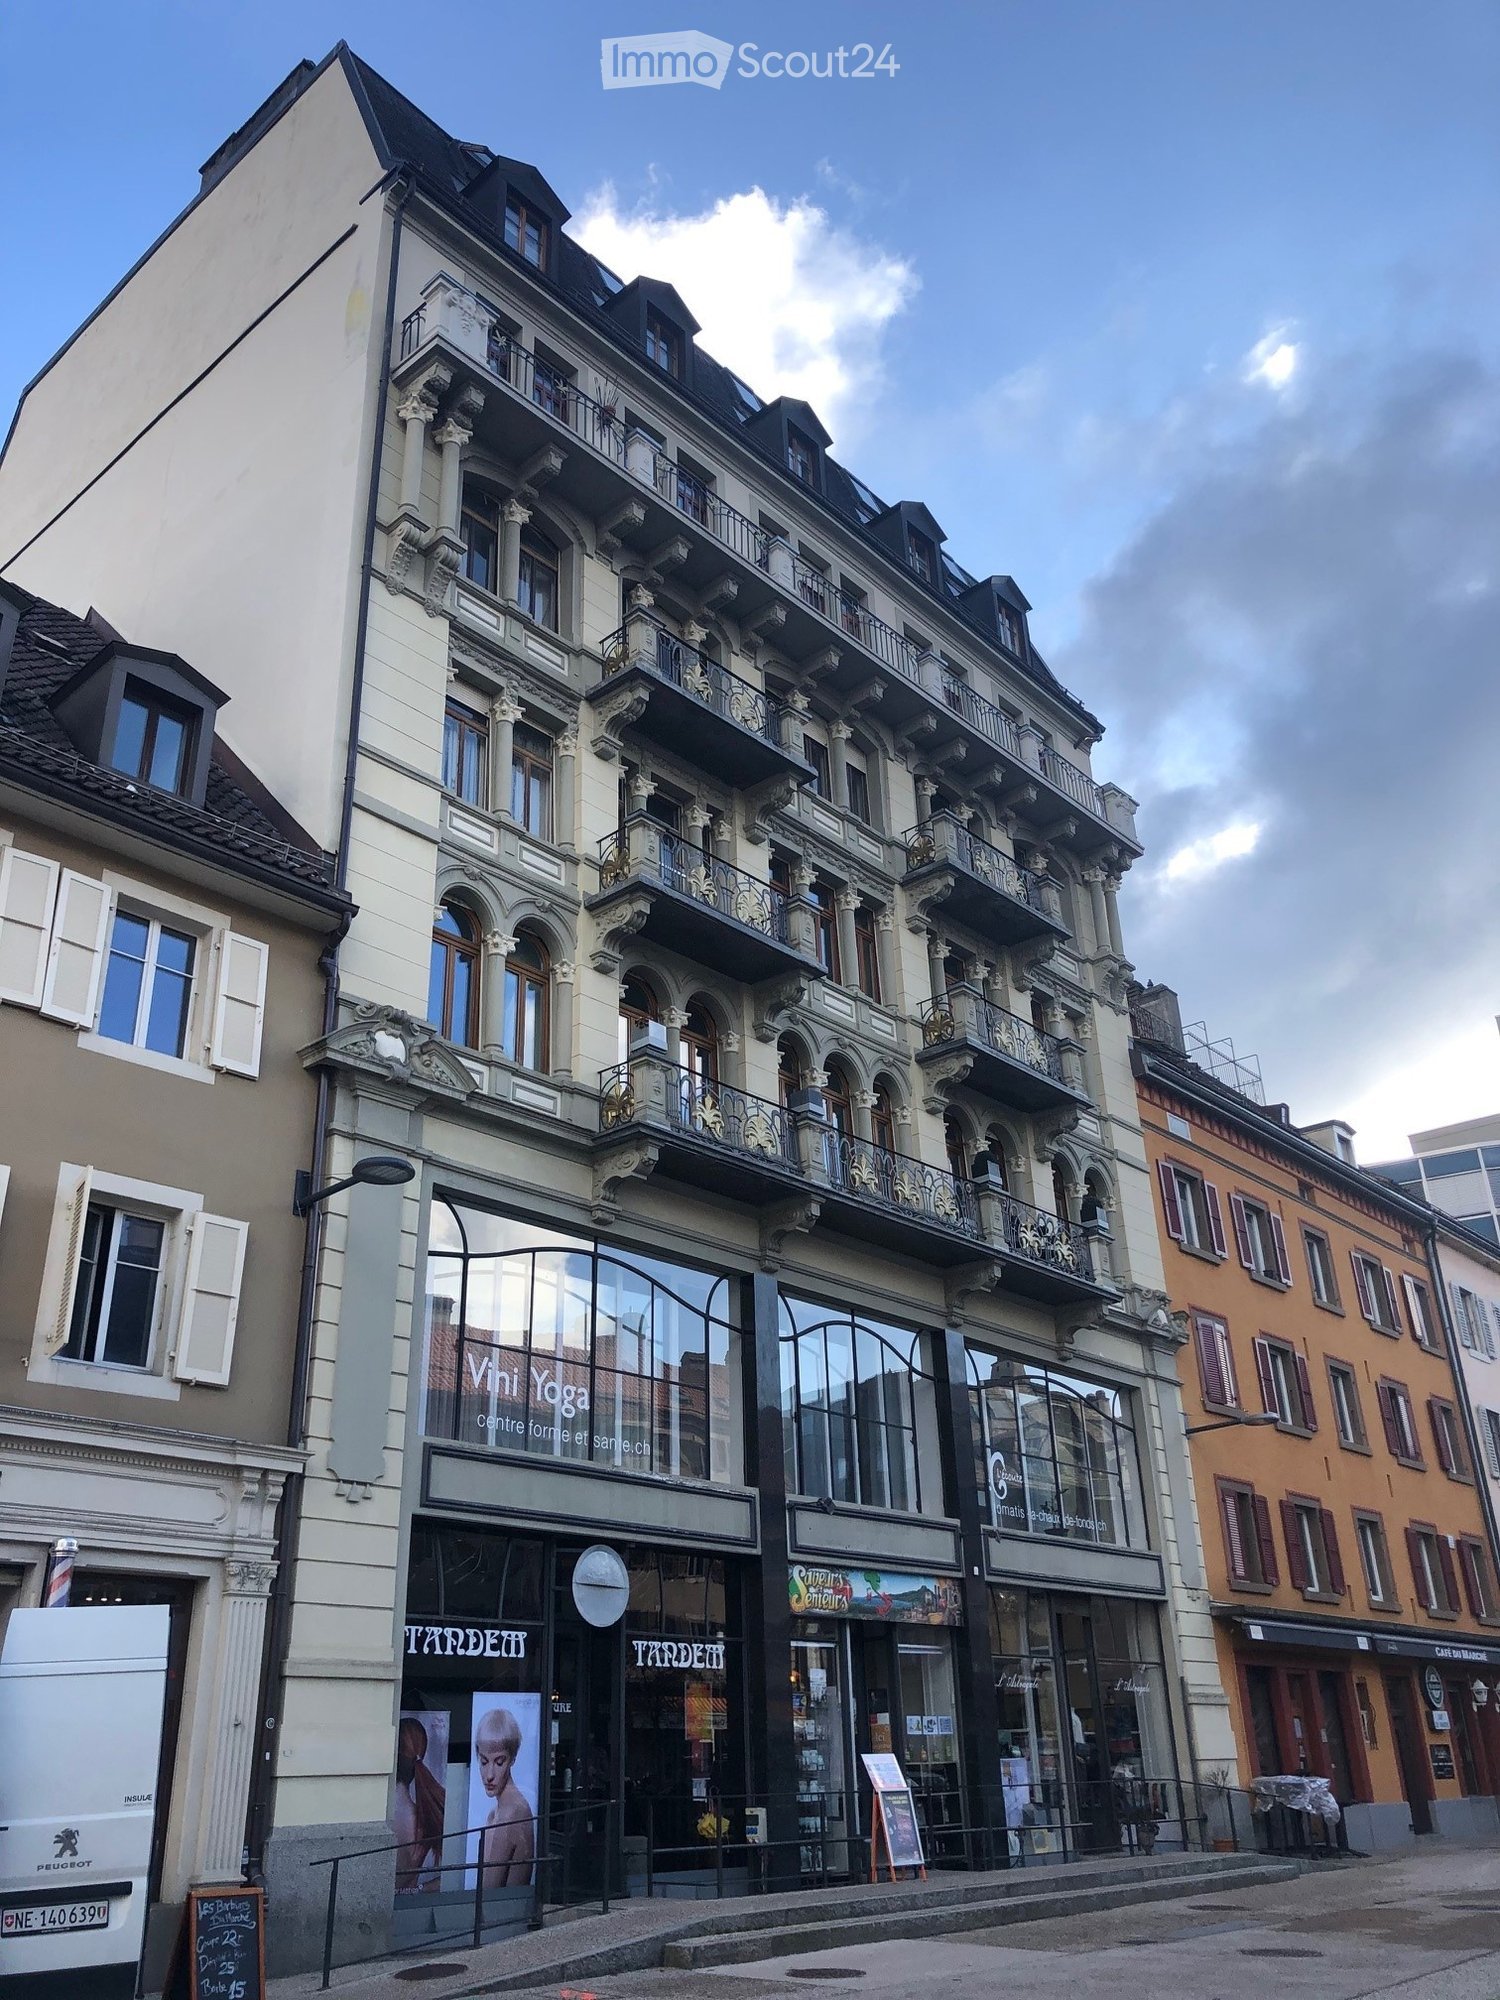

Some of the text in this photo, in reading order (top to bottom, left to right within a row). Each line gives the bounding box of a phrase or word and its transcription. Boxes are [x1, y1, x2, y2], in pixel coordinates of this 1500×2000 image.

[467, 1353, 590, 1418] Vini Yoga
[477, 1414, 651, 1455] centre forme et sane.ch
[404, 1625, 528, 1659] TANDEM
[632, 1640, 726, 1670] TANDEM
[37, 1860, 92, 1872] PEUGEOT
[198, 1901, 214, 1919] Les
